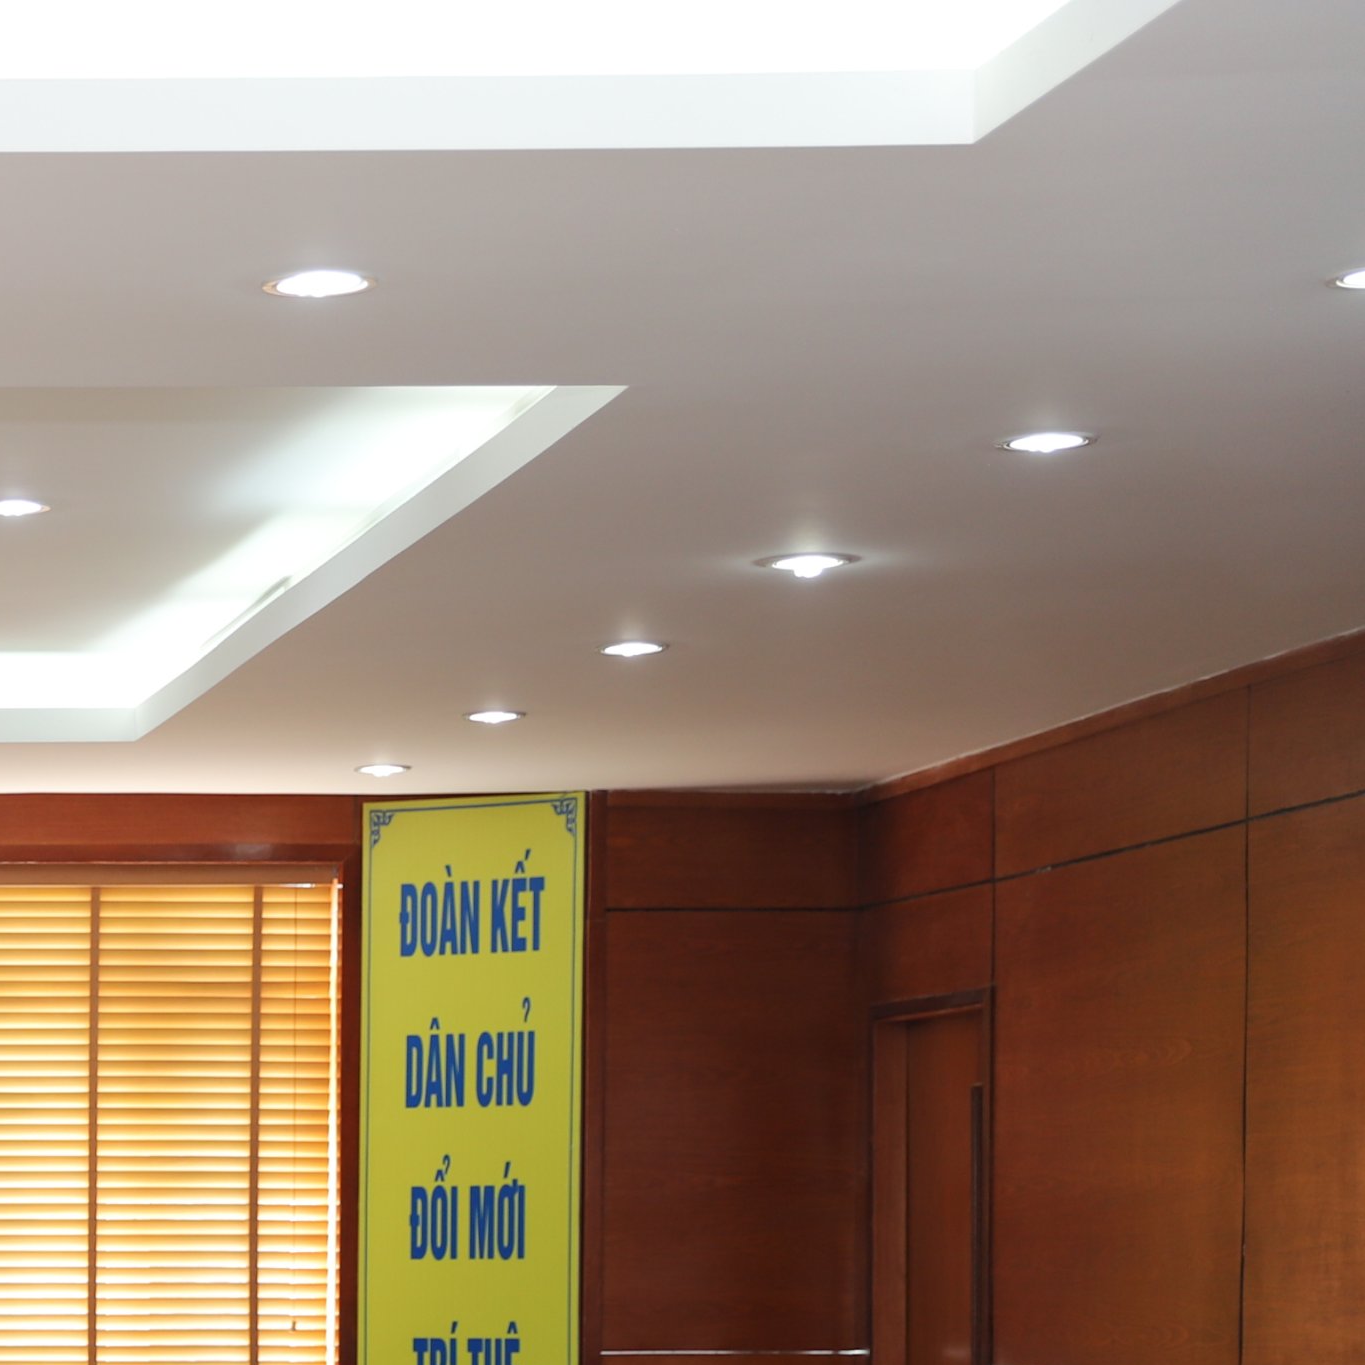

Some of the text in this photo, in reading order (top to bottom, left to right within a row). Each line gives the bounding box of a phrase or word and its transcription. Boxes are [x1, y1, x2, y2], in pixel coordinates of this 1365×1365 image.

[399, 849, 546, 958] ĐOÀN KẾT
[405, 997, 537, 1110] DÂN CHỦ
[409, 1154, 527, 1262] ĐỔI MỚI
